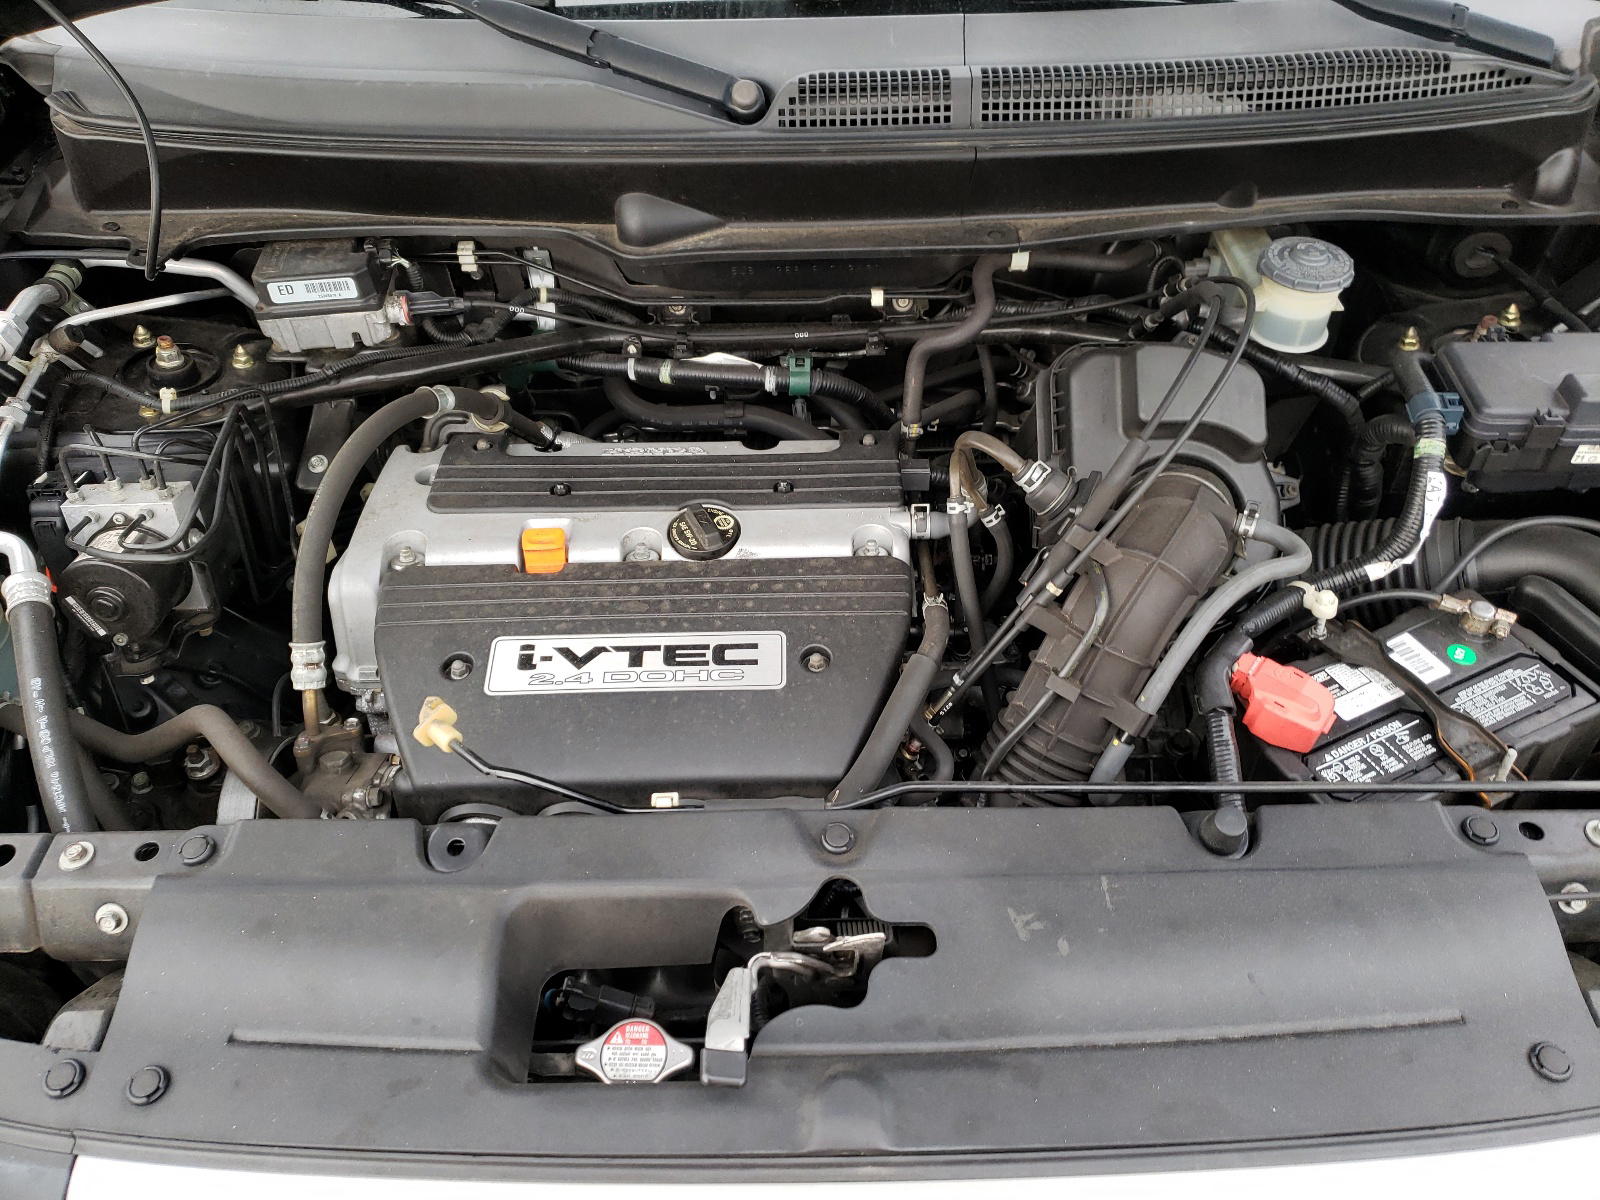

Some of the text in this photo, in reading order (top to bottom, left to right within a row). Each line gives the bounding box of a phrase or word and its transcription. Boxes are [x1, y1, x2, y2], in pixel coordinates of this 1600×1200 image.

[277, 284, 295, 296] ED
[516, 642, 759, 671] i-VTEC
[527, 668, 745, 686] 2.4 DOHC
[1330, 736, 1367, 758] DANGER
[1370, 720, 1403, 741] POISON
